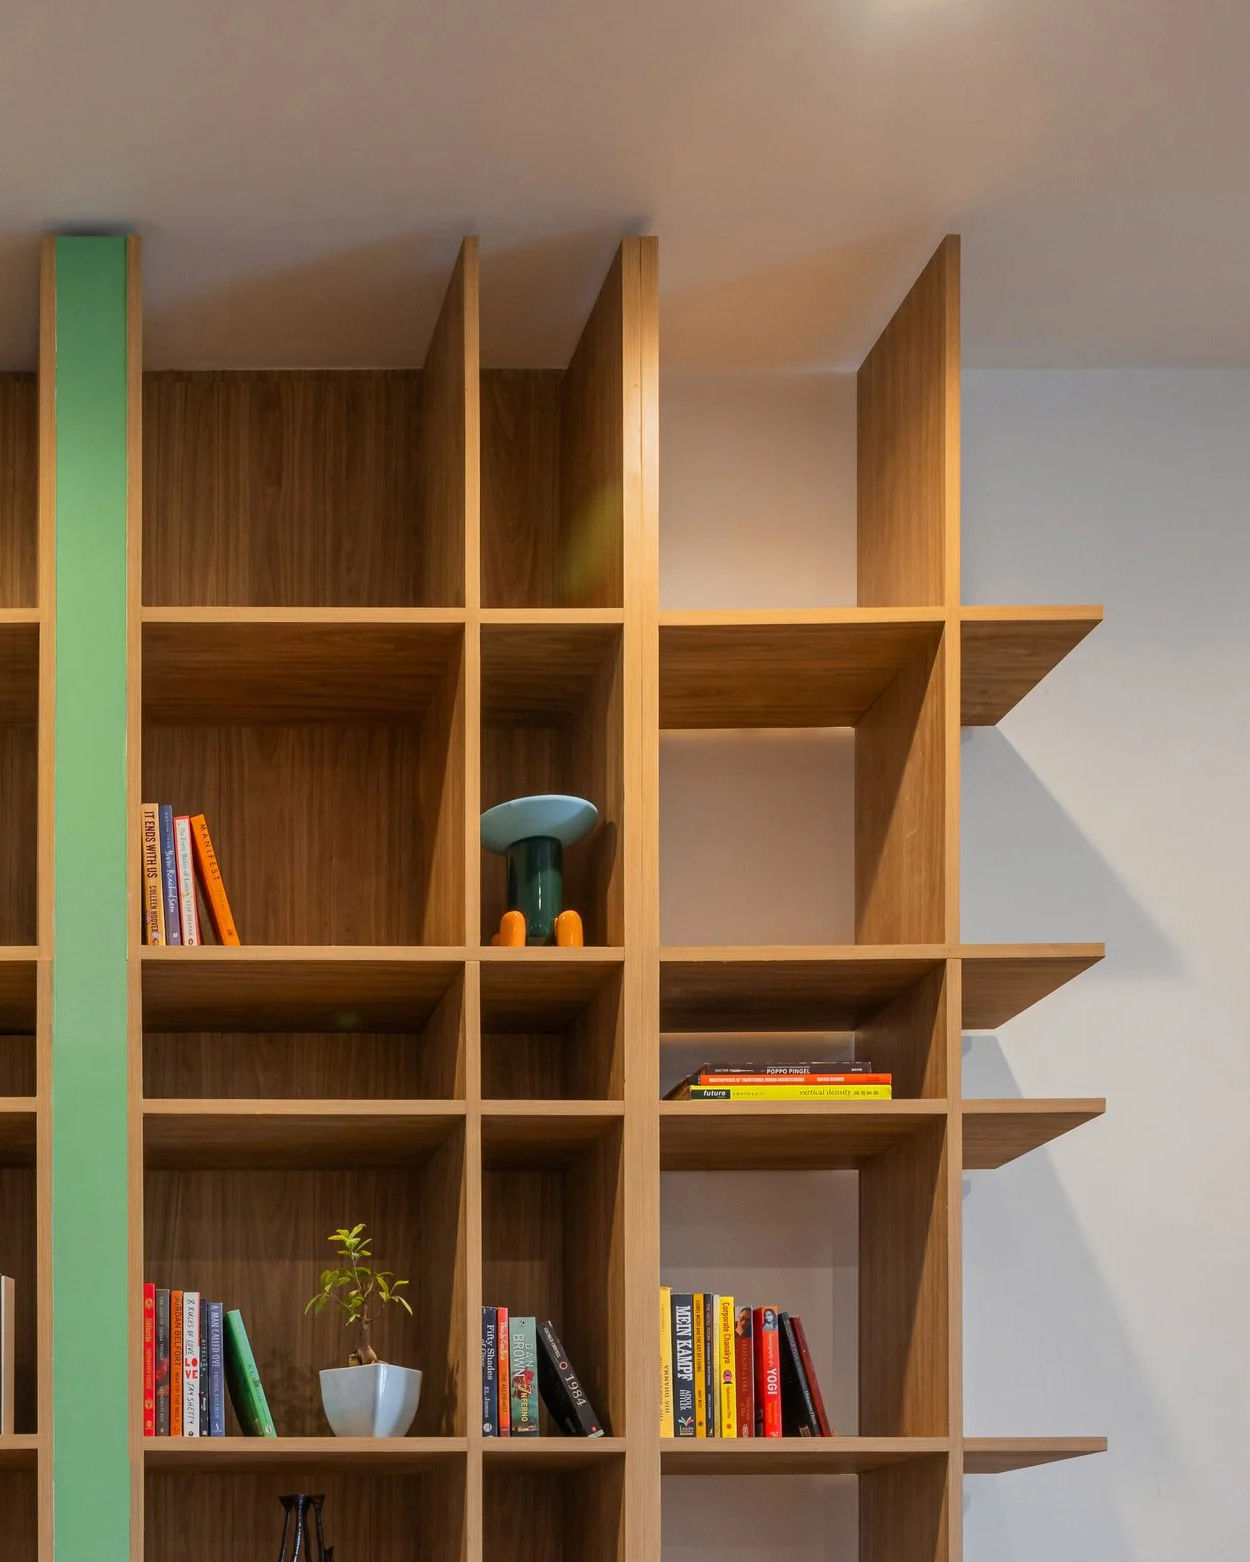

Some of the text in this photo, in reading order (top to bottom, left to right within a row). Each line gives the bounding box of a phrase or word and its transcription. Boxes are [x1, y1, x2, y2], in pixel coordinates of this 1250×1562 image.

[144, 811, 158, 879] IT ENDS WITH US
[199, 824, 221, 881] MANIFEST
[149, 885, 157, 909] COLLEEN
[211, 1312, 219, 1328] MAN
[721, 1302, 732, 1364] Corporate Chanakya
[187, 1339, 195, 1356] LOVE
[212, 1329, 220, 1353] CALLED
[487, 1324, 495, 1381] Fifty Shades
[512, 1334, 525, 1377] BROWN
[525, 1343, 533, 1367] DAN
[676, 1305, 693, 1381] MEIN KAMPF
[565, 1373, 587, 1407] 1984
[767, 1368, 778, 1395] YOGI
